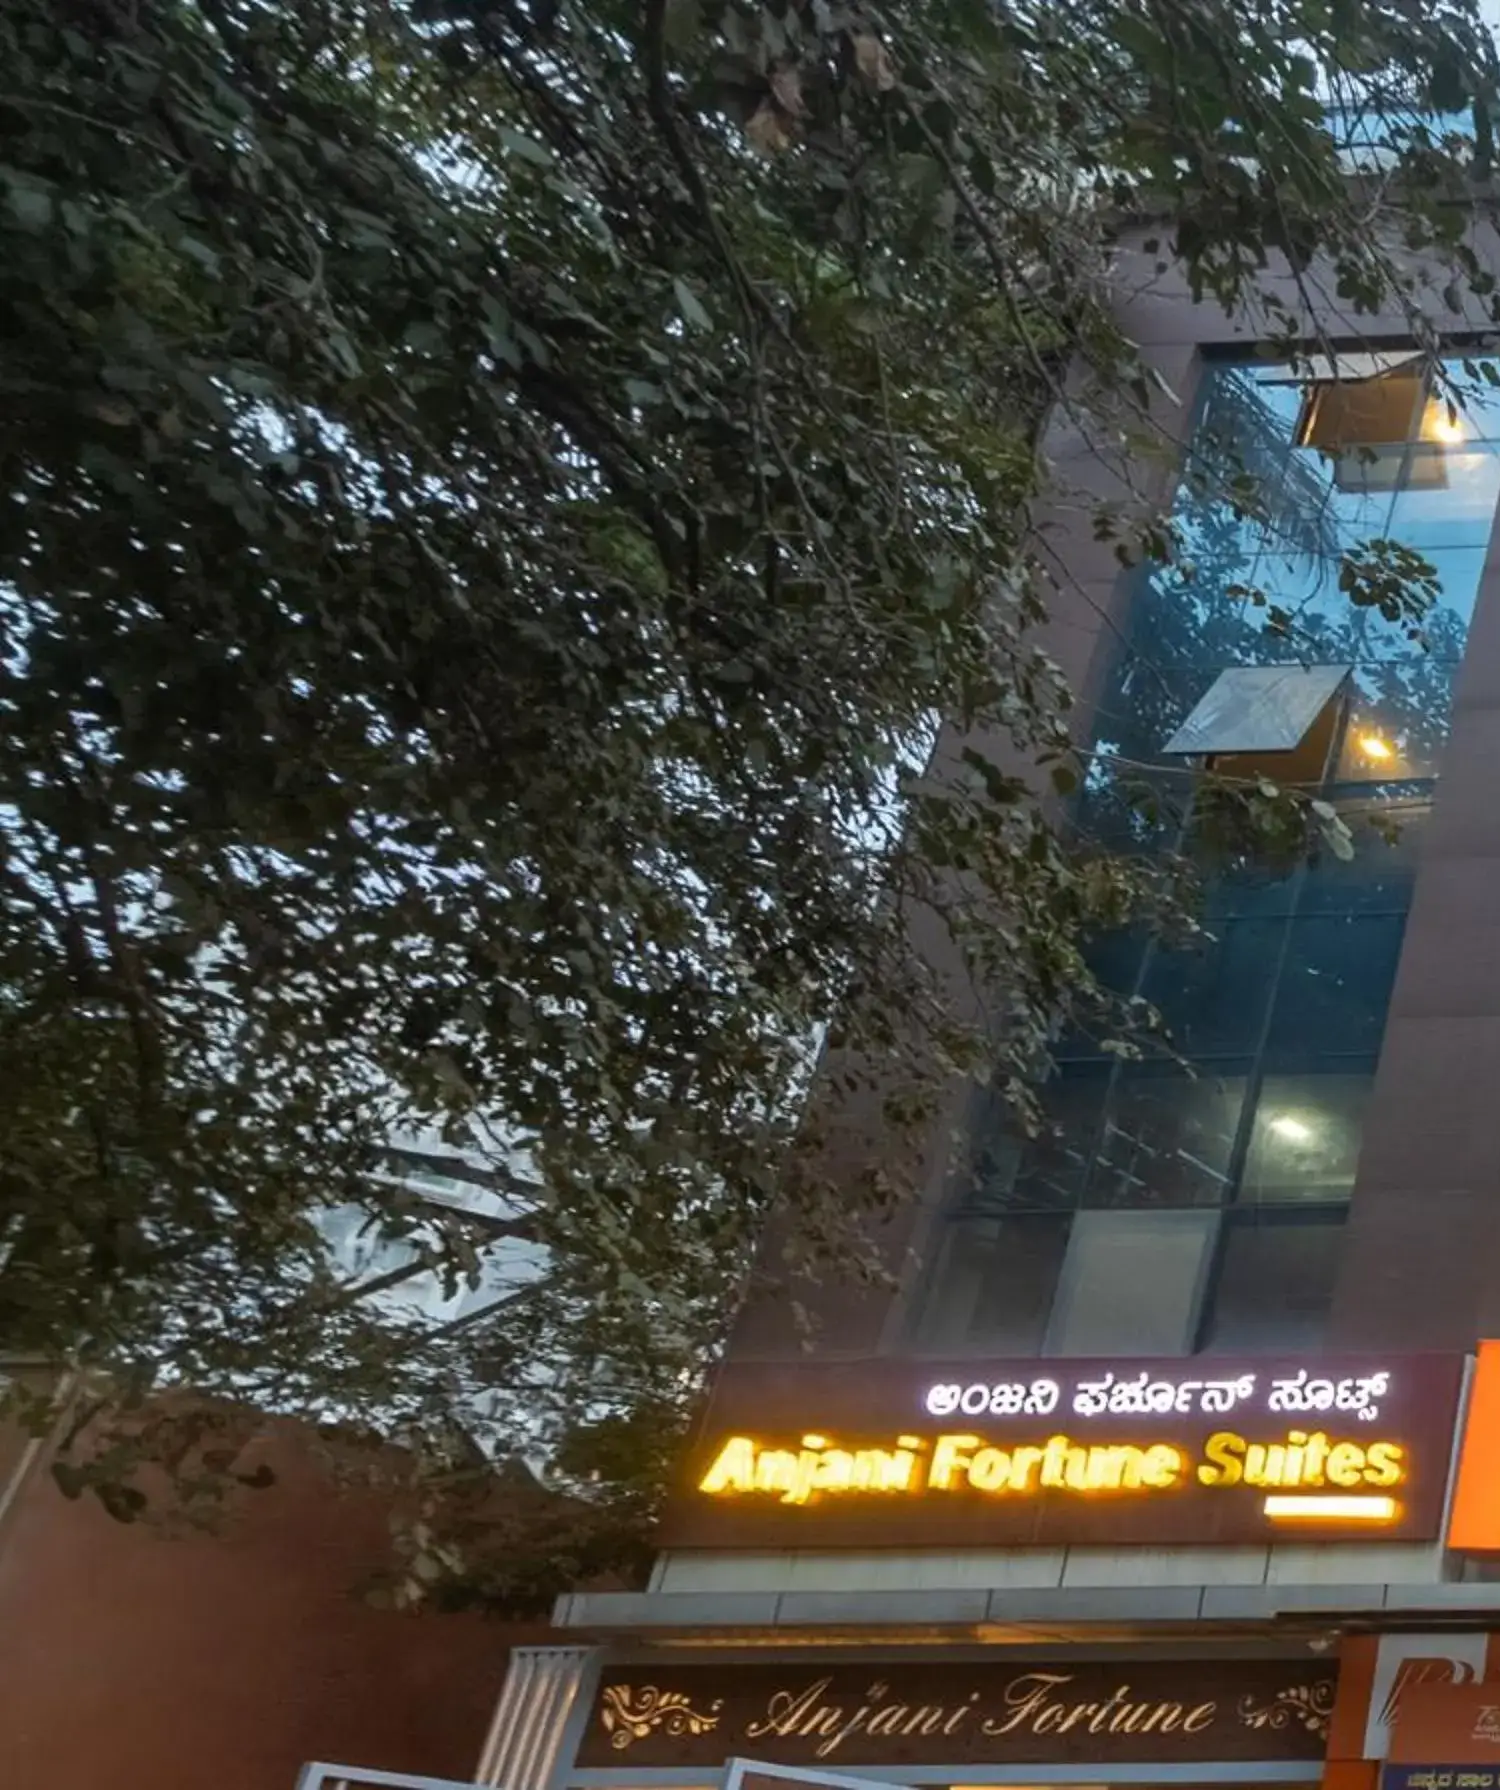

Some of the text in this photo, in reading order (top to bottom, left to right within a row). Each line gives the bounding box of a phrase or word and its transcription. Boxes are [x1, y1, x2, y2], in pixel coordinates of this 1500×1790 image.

[926, 1379, 1060, 1416] ಅಂಜನಿ
[700, 1430, 1405, 1505] Anjani Fortune Suites
[746, 1672, 1217, 1757] Anjani Fortune
